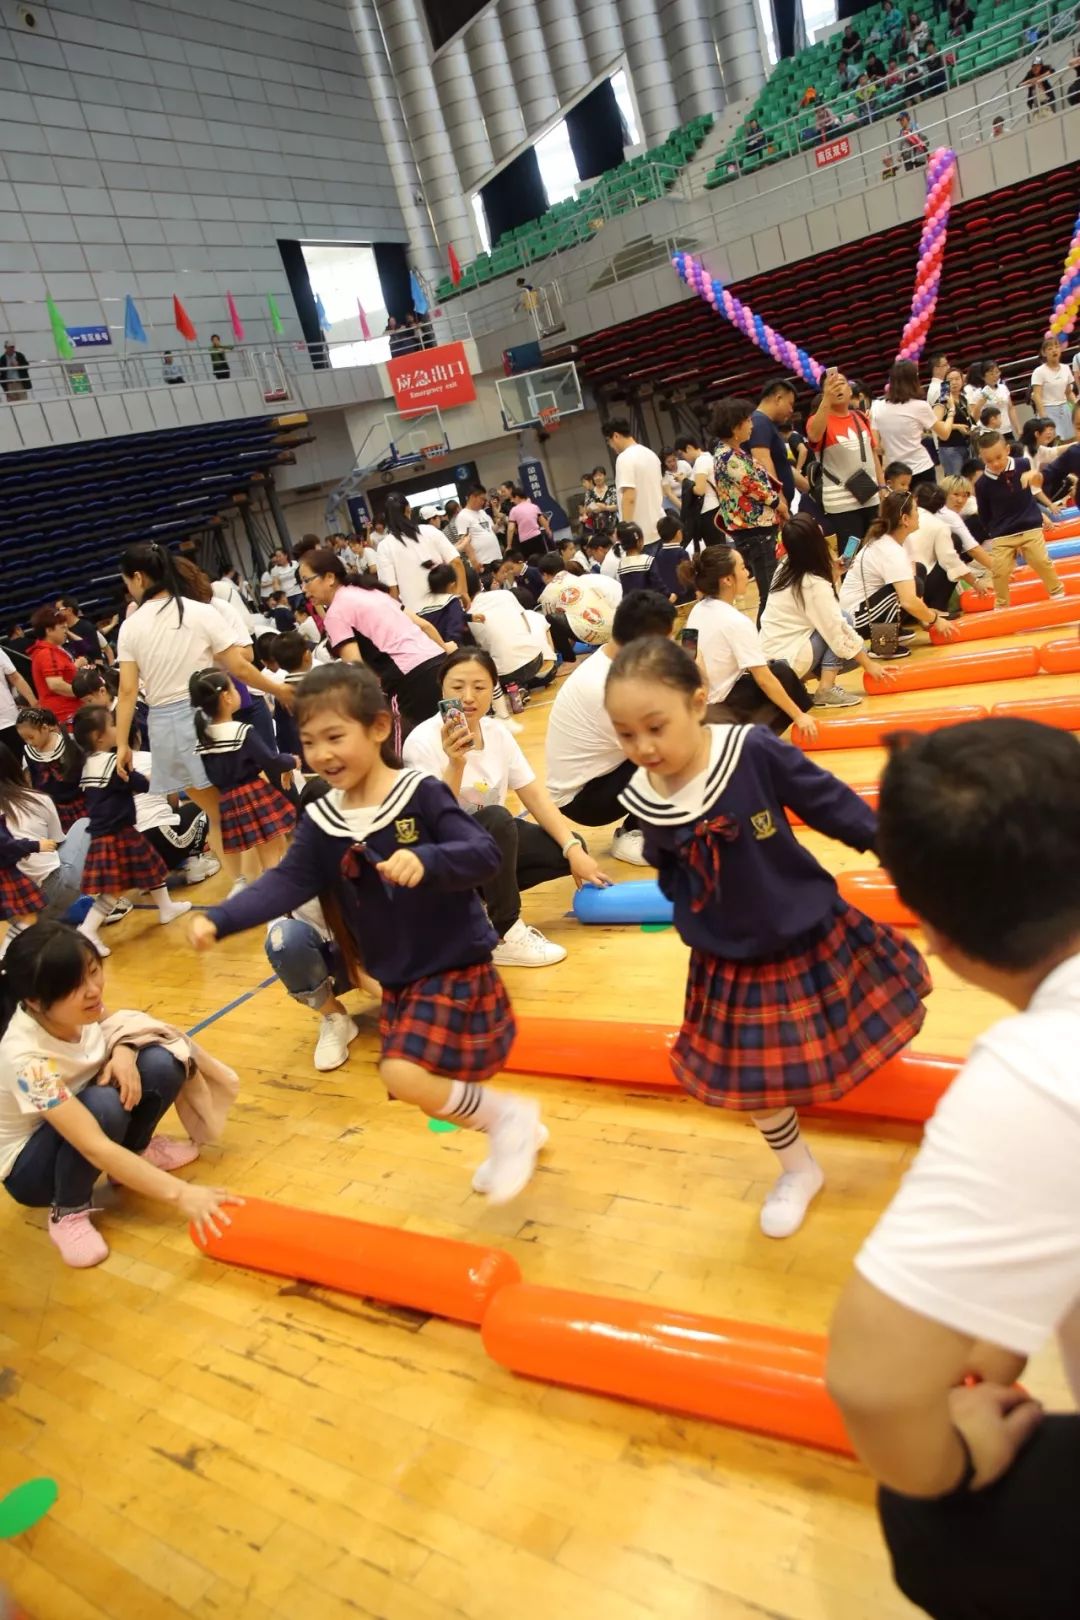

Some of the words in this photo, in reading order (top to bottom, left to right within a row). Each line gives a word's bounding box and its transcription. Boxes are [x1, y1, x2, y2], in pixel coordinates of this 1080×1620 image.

[396, 361, 464, 393] 应急出口
[410, 385, 443, 399] Emergency
[445, 381, 458, 390] exit
